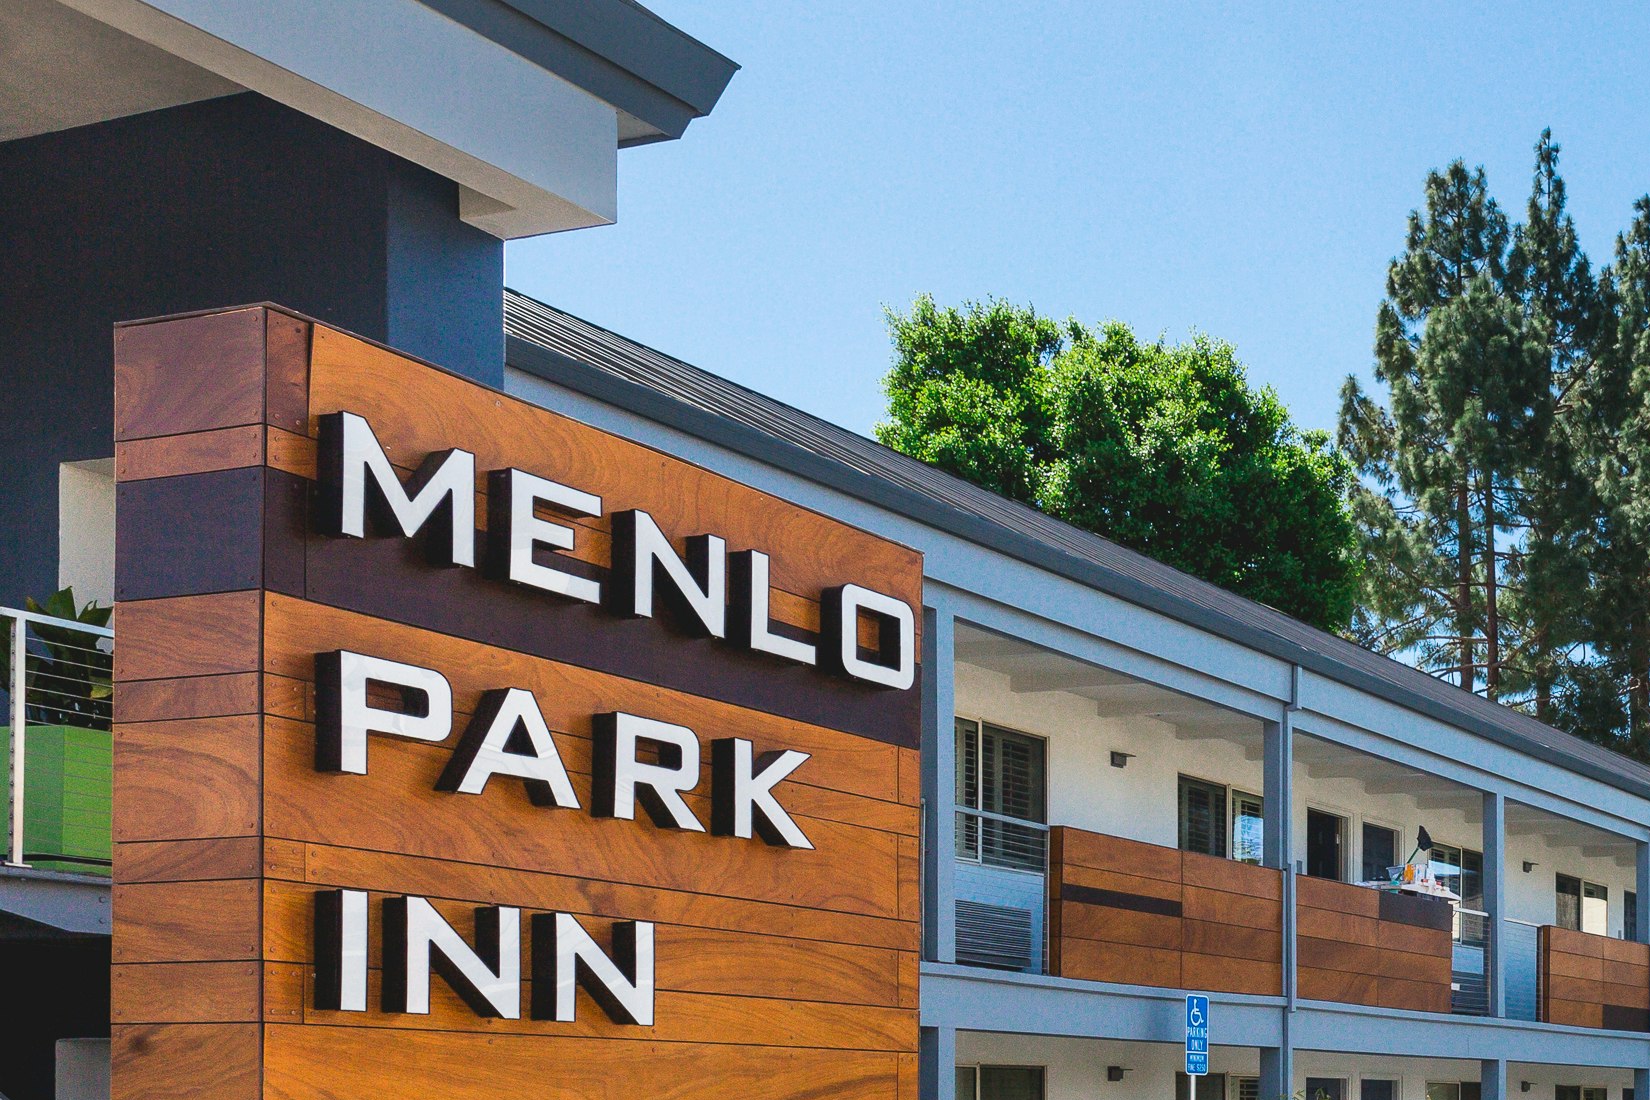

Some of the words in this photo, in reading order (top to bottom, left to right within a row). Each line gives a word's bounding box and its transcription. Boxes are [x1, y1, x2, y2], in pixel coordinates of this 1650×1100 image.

[338, 410, 916, 691] MENLO
[338, 648, 814, 850] PARK
[338, 887, 656, 1027] INN
[1187, 1026, 1207, 1038] PARKING
[1191, 1039, 1204, 1051] ONLY
